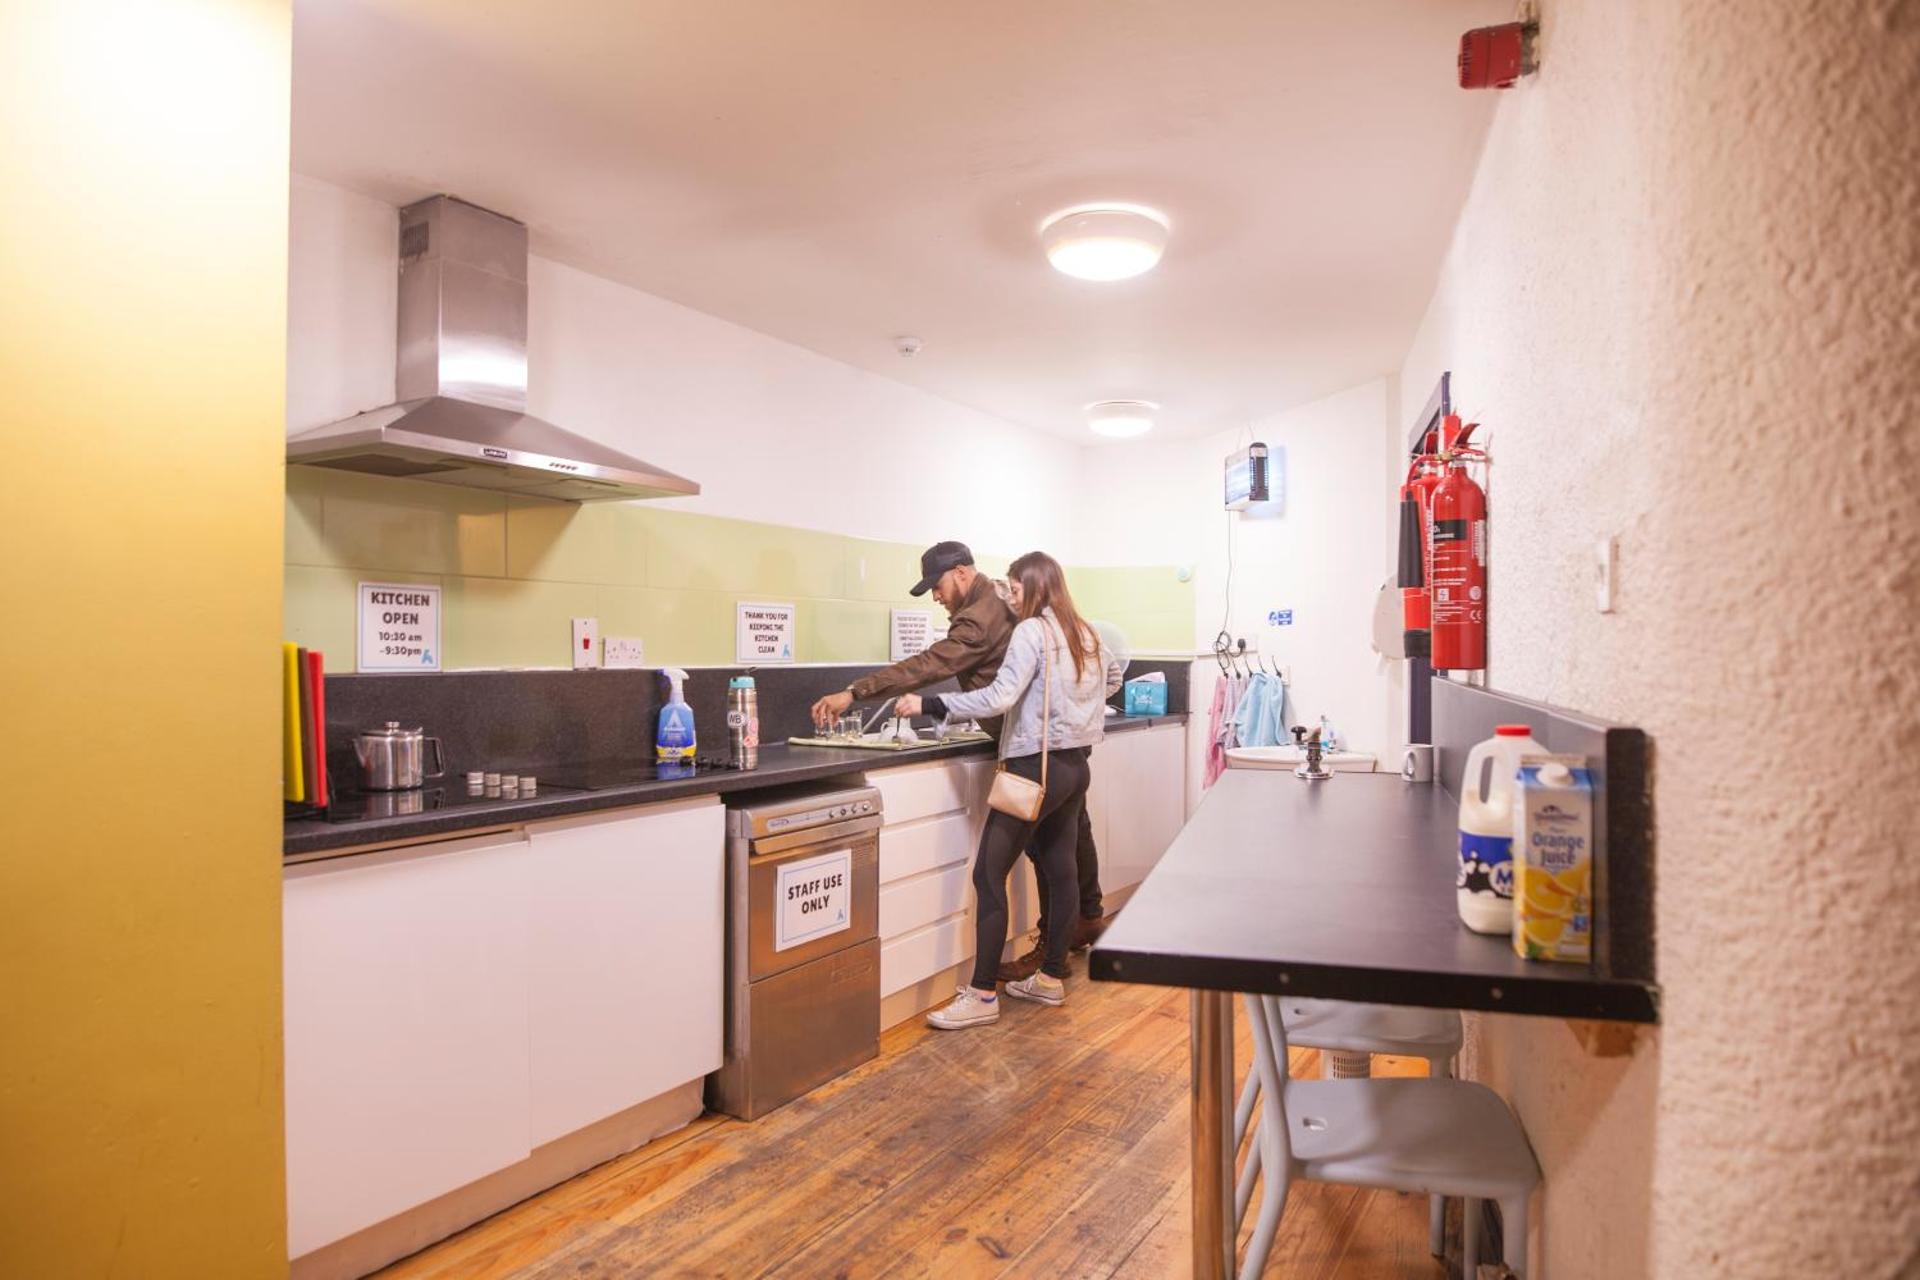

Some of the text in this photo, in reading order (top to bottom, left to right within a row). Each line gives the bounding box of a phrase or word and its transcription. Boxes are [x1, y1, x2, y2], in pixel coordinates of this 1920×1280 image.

[371, 592, 430, 606] KITCHEN
[383, 612, 418, 625] OPEN
[745, 612, 764, 620] THANK
[1531, 831, 1585, 849] Orange
[788, 874, 843, 900] STAFF USE
[801, 894, 830, 914] ONLY
